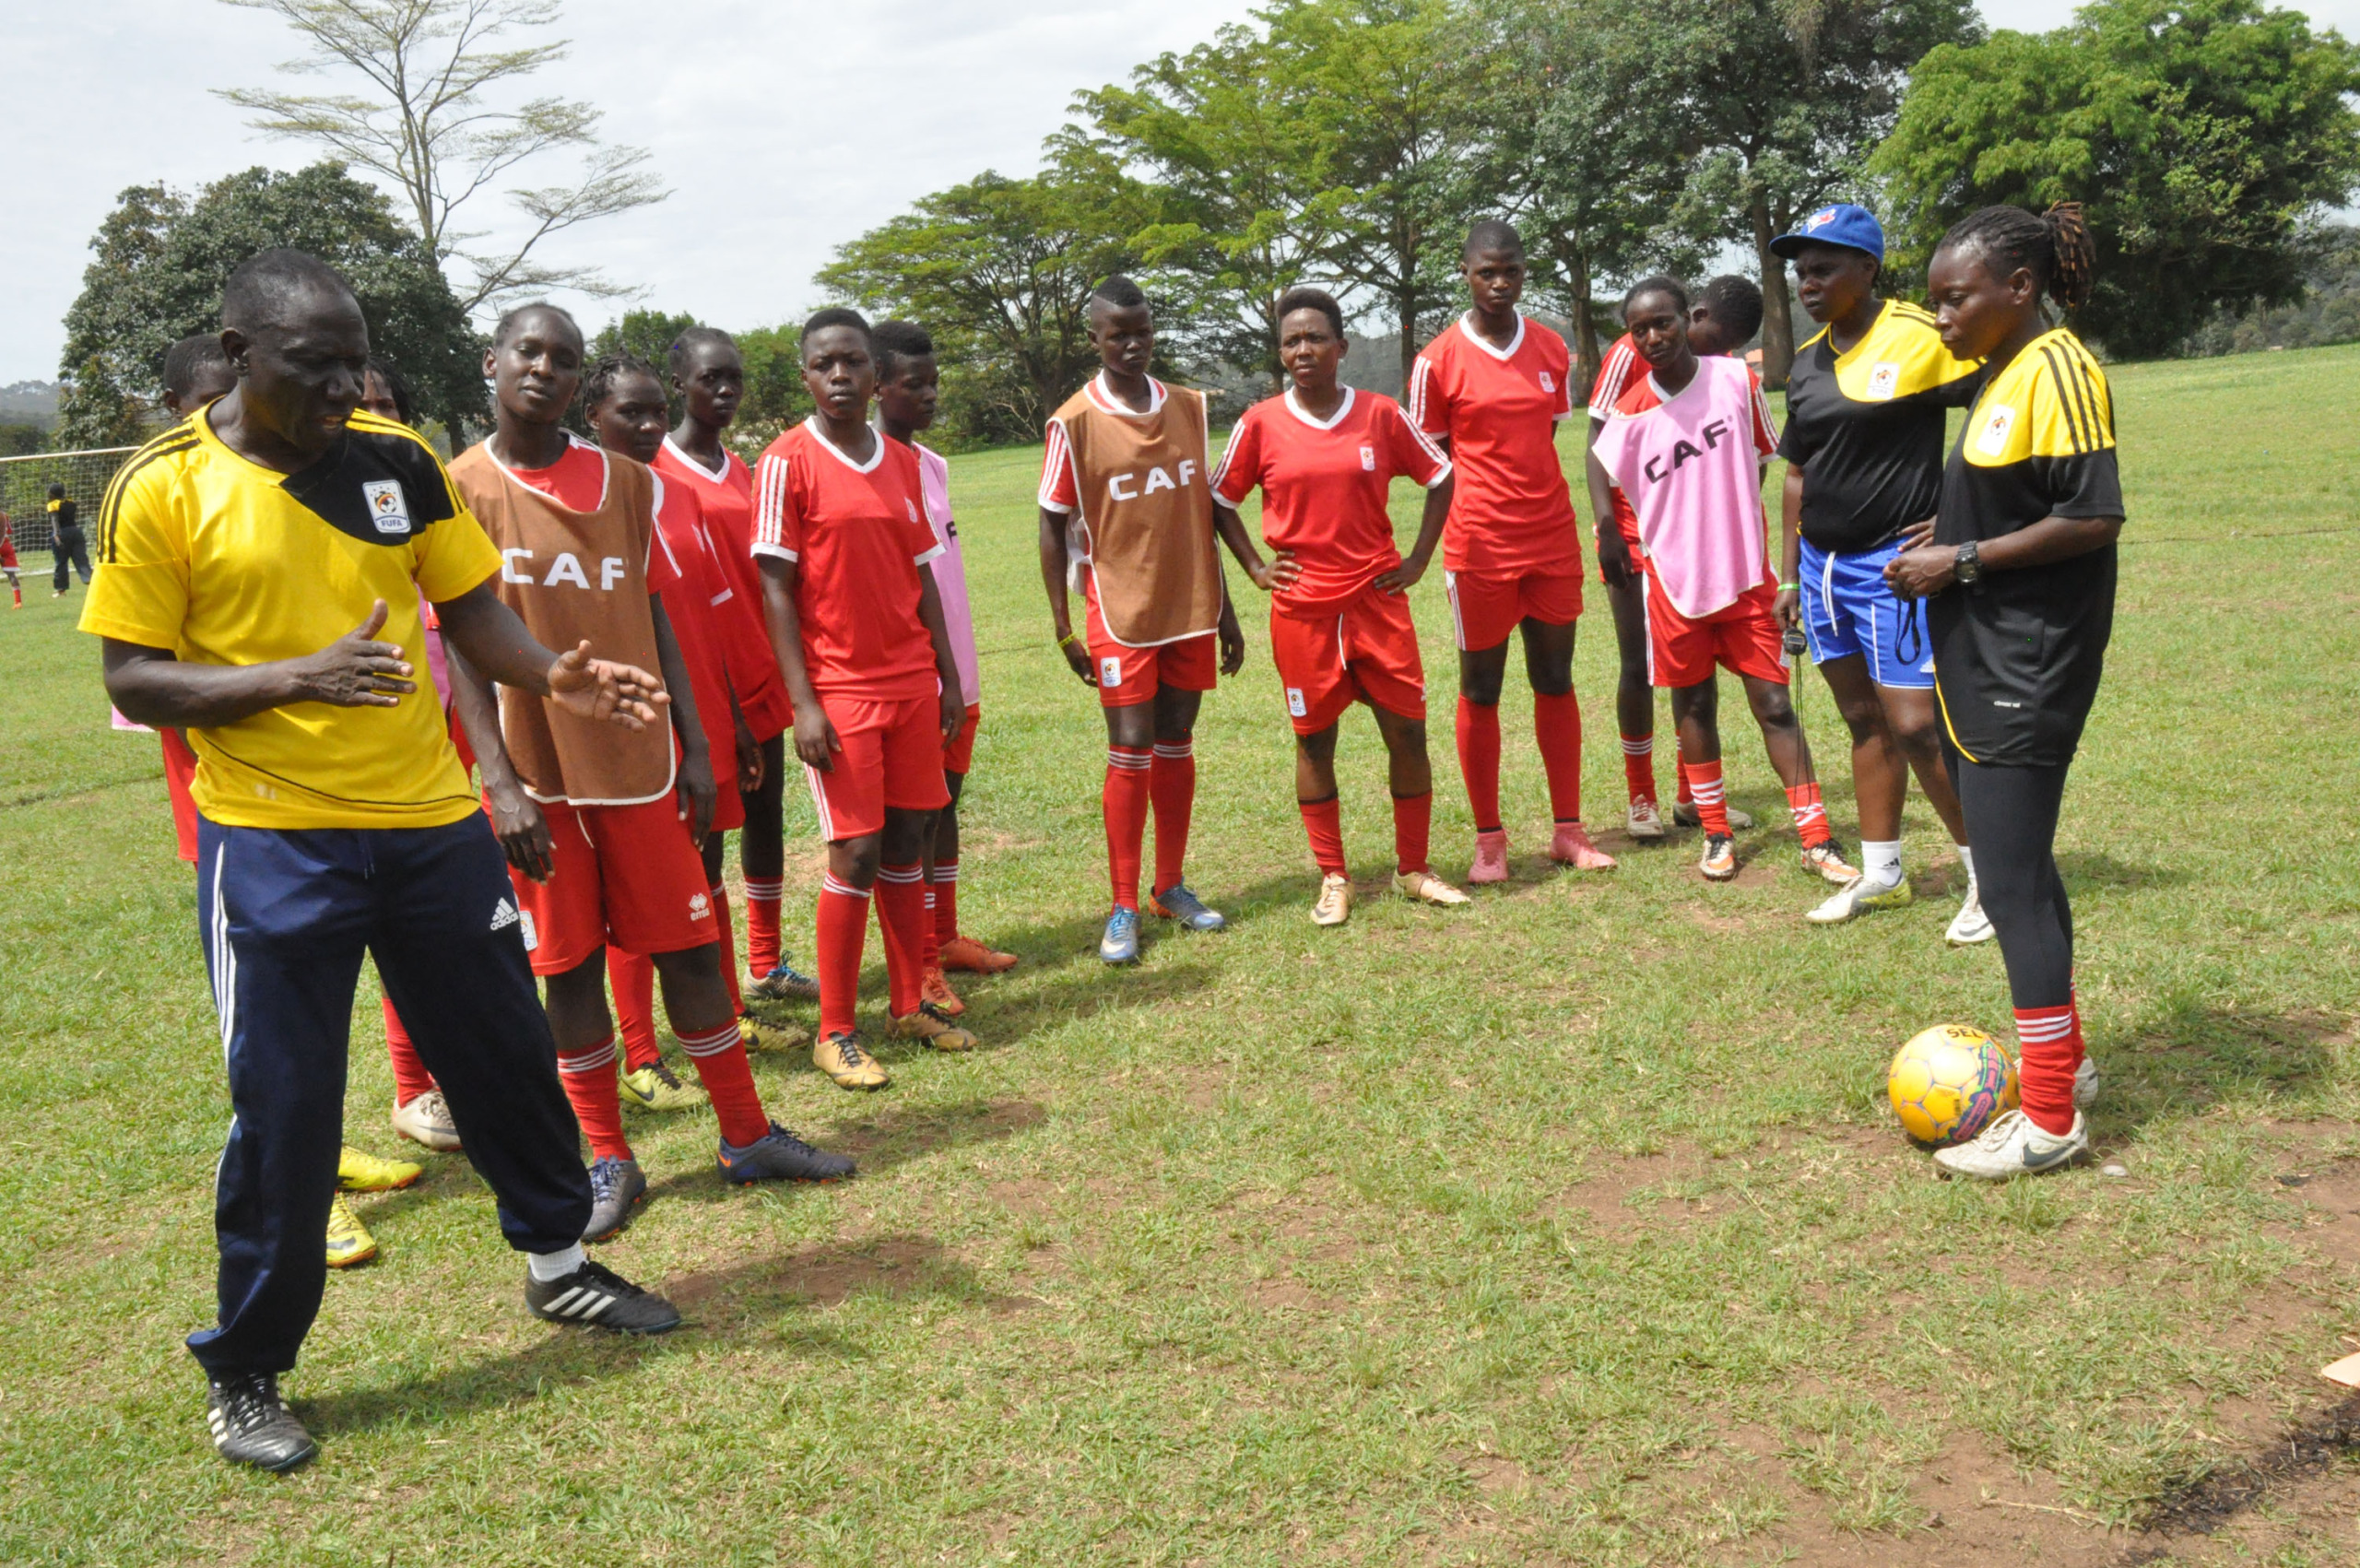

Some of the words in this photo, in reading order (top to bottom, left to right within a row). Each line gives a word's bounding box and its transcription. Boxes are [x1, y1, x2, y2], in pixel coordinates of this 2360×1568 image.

[1644, 418, 1729, 485] CAF
[1108, 458, 1197, 501] CAF
[381, 519, 403, 527] FUFA
[502, 547, 626, 591] CAF
[490, 911, 519, 931] adida
